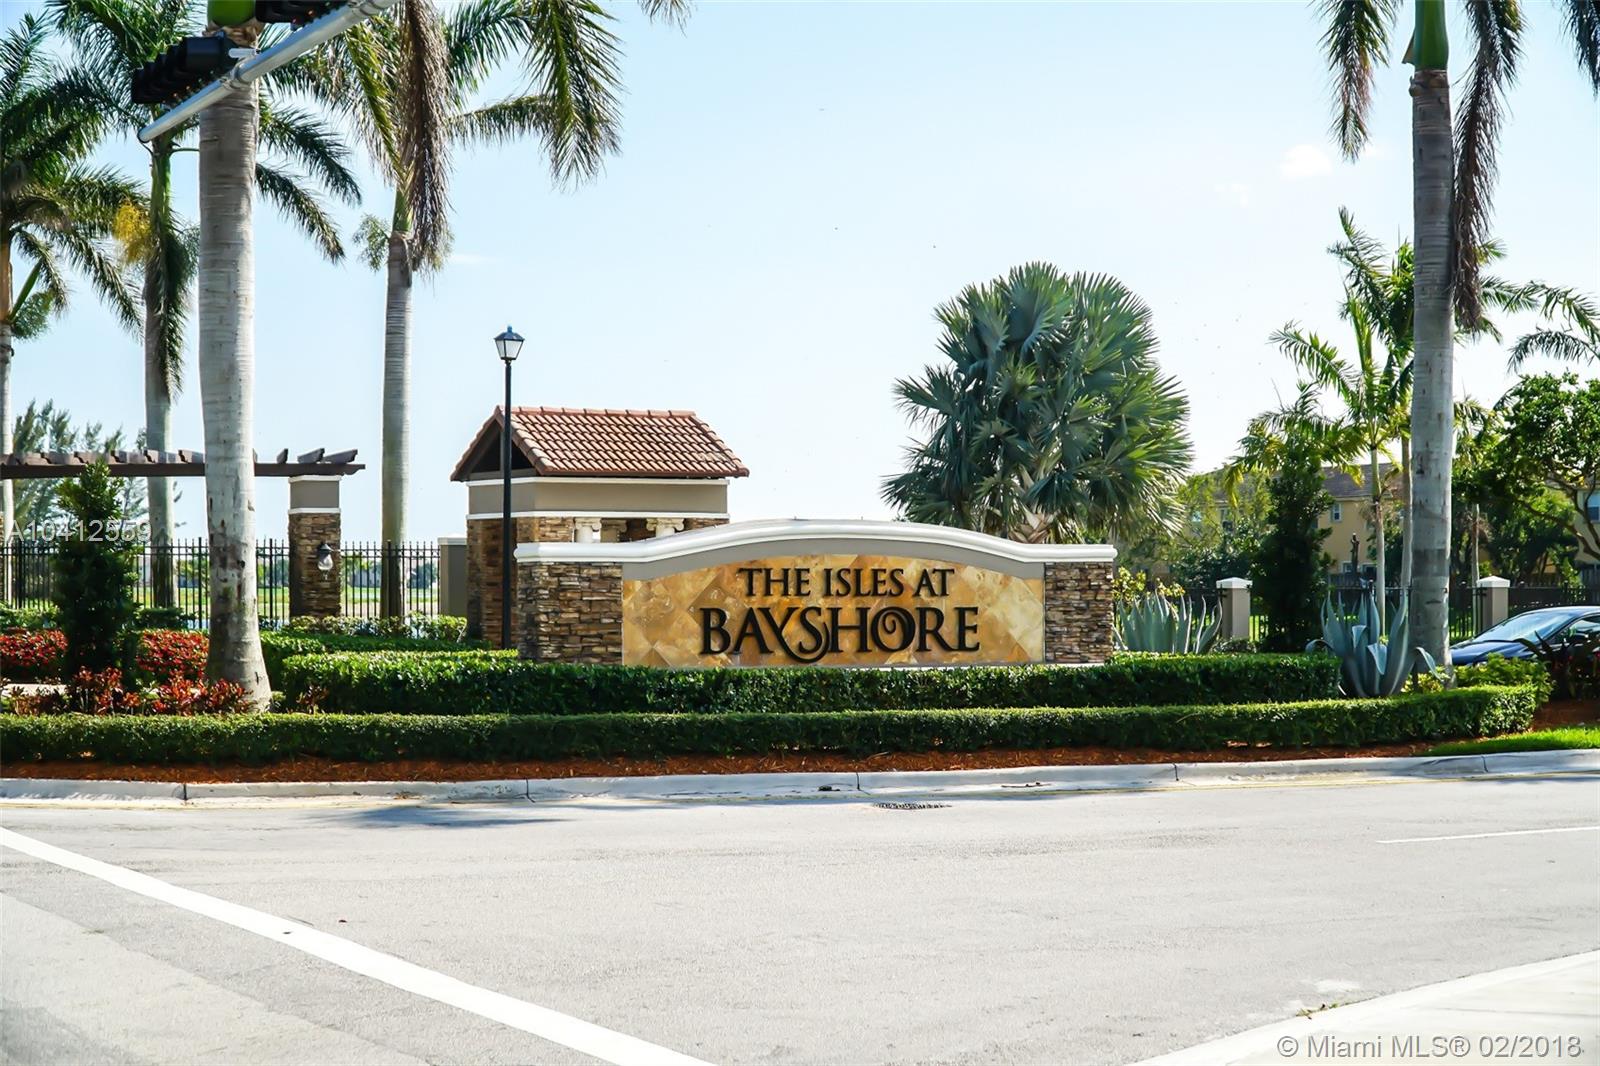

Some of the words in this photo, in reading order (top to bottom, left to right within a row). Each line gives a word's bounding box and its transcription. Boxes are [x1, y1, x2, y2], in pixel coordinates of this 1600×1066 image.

[739, 567, 811, 598] THE
[822, 567, 904, 598] ISLES
[912, 567, 955, 598] AT
[699, 606, 980, 664] BAYSHORE
